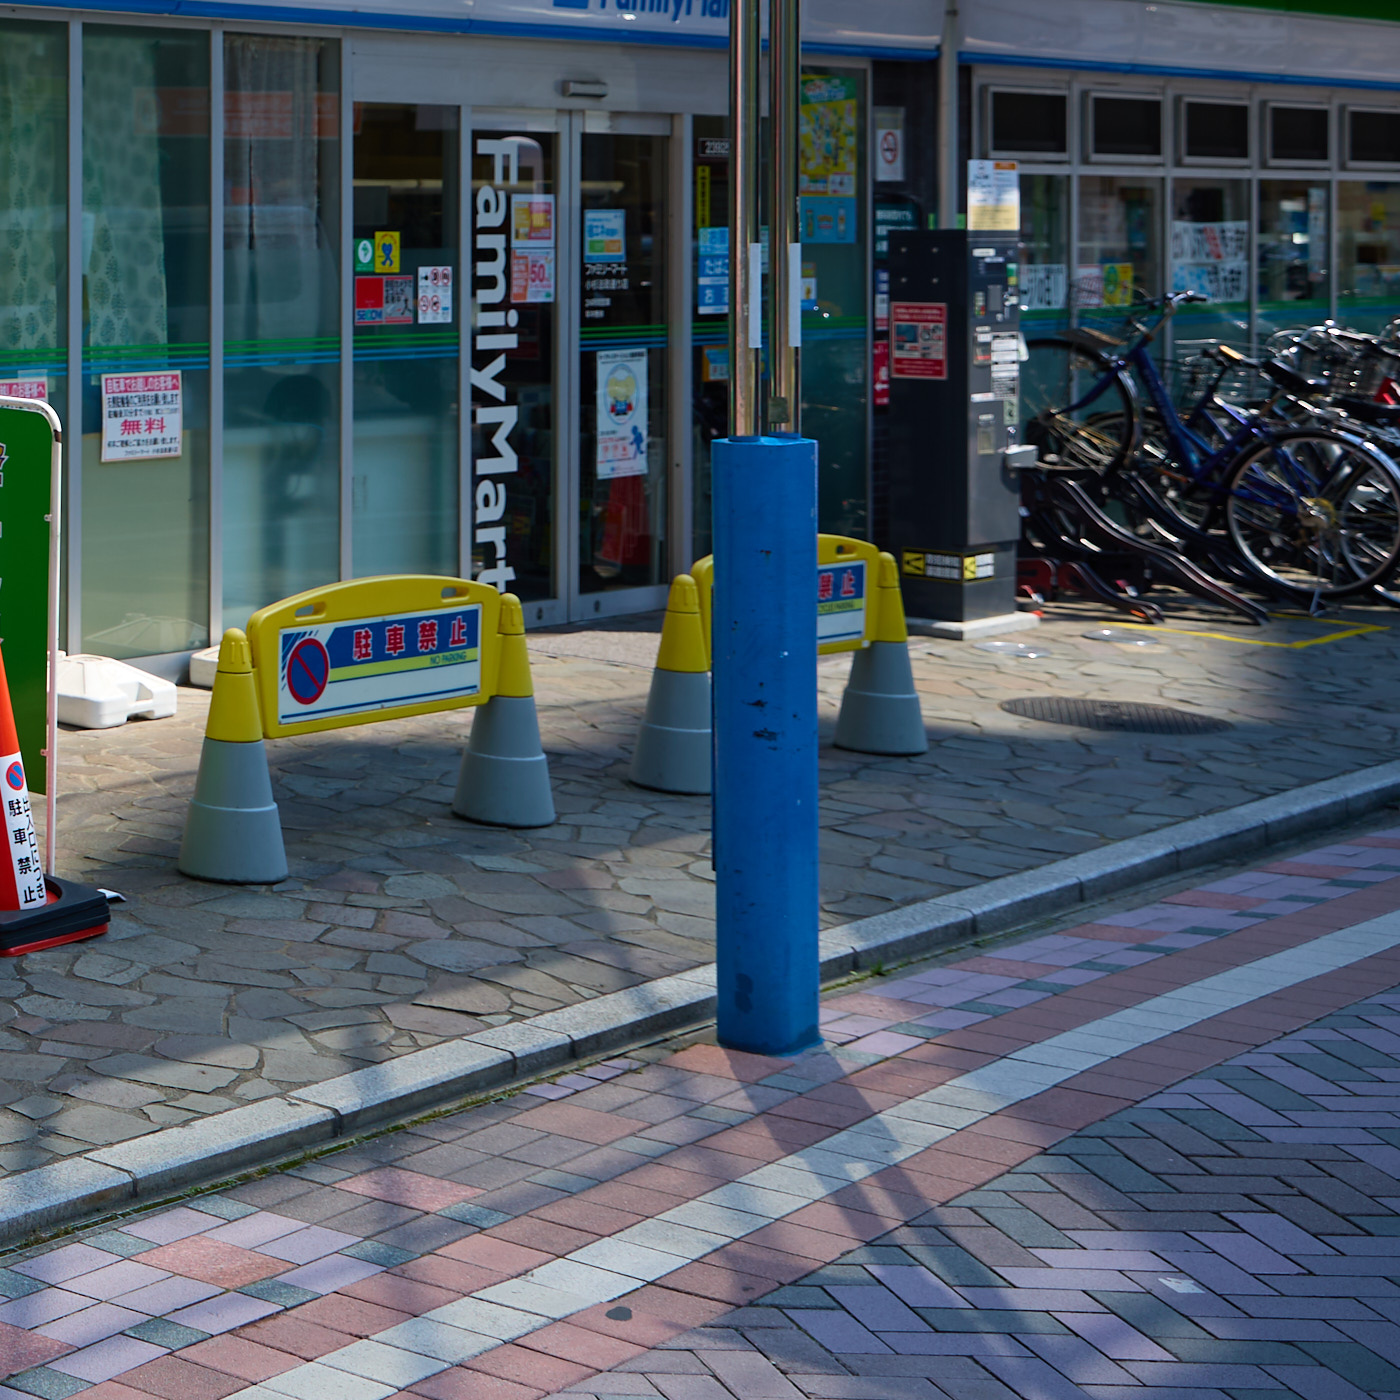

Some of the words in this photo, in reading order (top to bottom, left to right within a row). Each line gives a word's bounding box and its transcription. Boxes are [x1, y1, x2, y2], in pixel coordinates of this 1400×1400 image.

[469, 138, 519, 593] FamilyMart
[120, 416, 167, 436] 無料
[818, 568, 856, 601] 禁止
[351, 618, 469, 662] 駐車禁止
[429, 655, 444, 667] NO
[445, 651, 467, 665] PARKING
[8, 798, 37, 904] 駐車禁止
